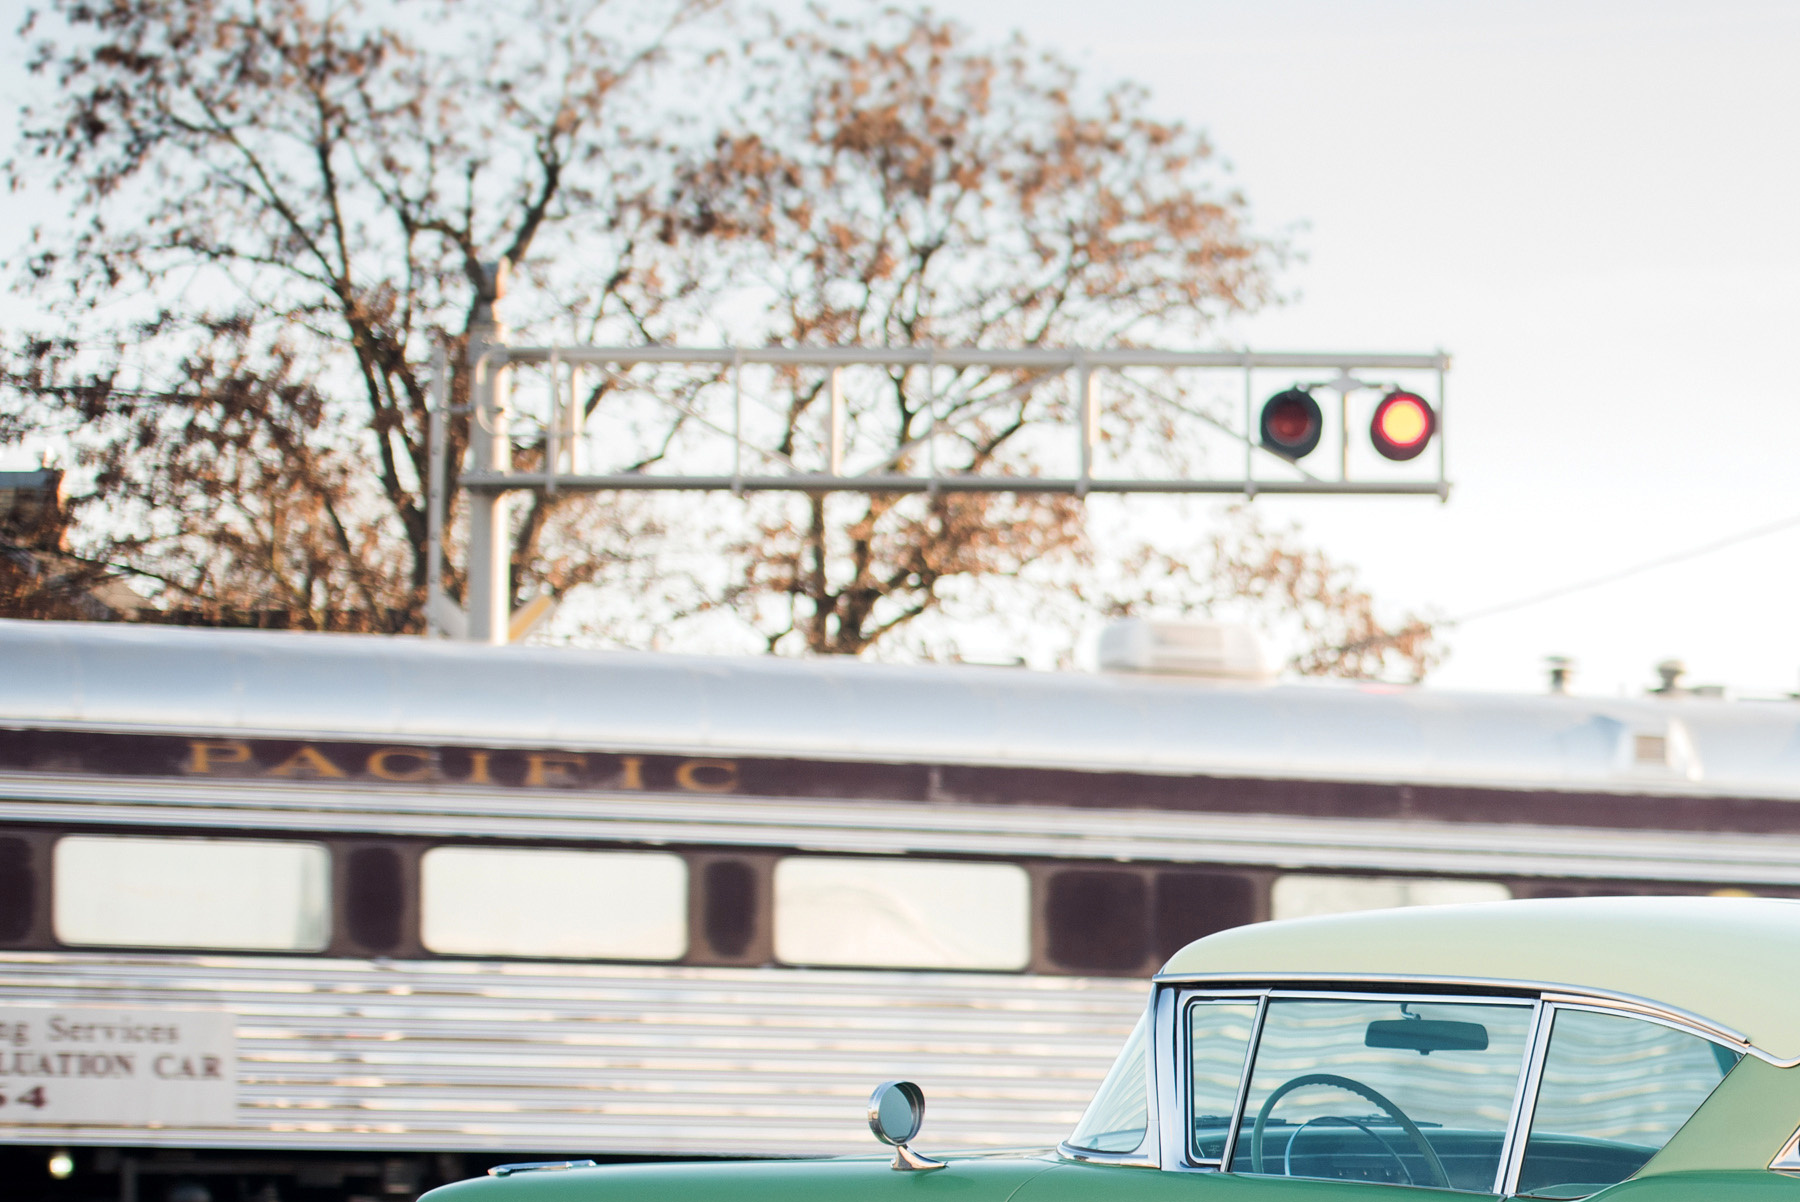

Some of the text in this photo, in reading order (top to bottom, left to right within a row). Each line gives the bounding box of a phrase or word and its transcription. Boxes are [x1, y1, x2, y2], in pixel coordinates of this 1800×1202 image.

[187, 740, 738, 793] PACIFIC
[48, 1014, 181, 1044] Services
[152, 1055, 222, 1080] CAR
